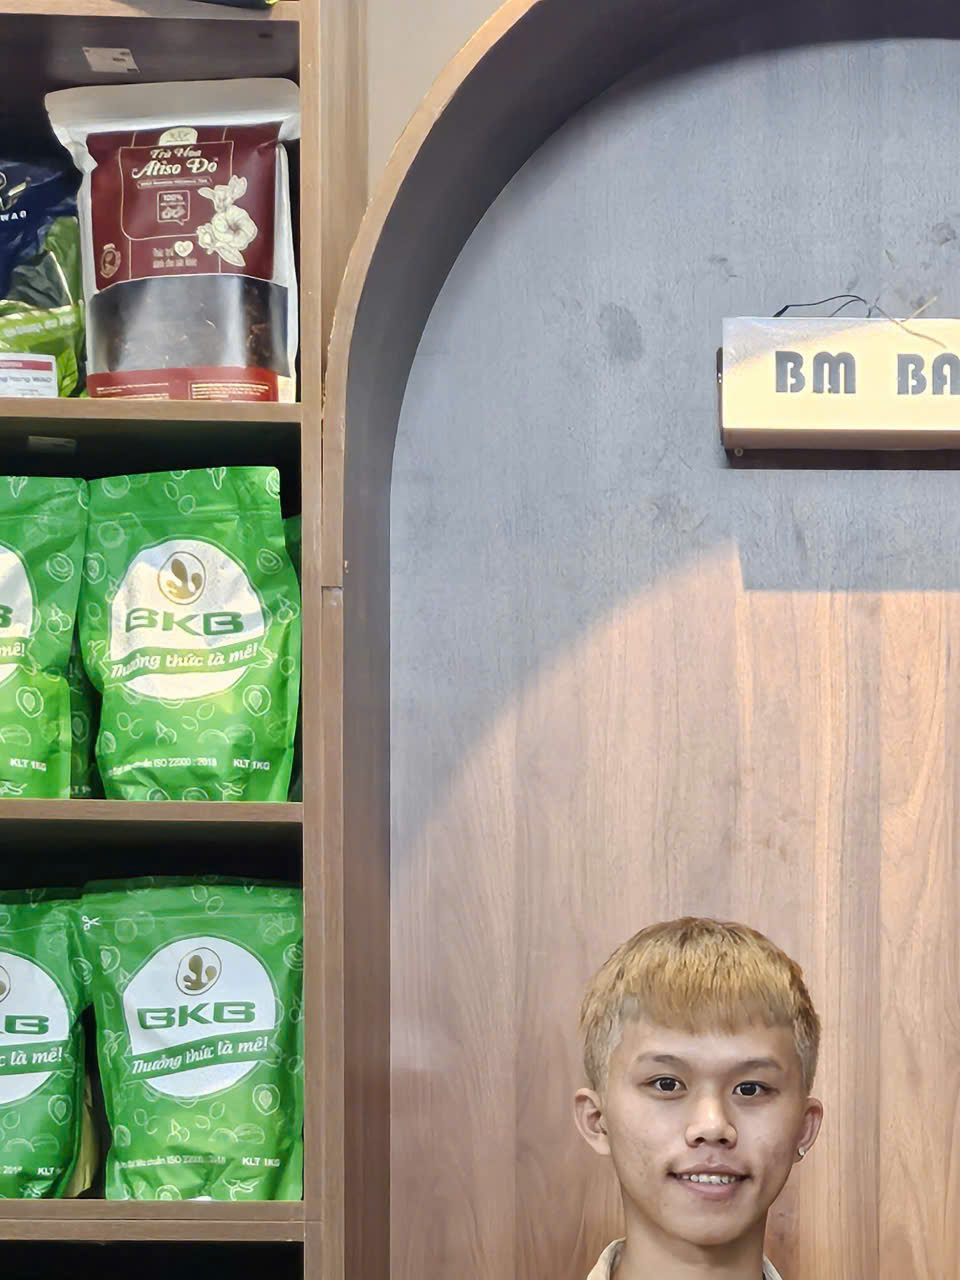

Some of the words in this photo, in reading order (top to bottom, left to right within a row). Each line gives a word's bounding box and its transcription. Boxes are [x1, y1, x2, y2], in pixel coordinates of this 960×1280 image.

[775, 350, 856, 394] BM
[125, 607, 245, 637] BKB
[208, 652, 226, 666] là
[233, 758, 250, 768] KLT
[252, 759, 270, 771] 1KG
[137, 1001, 256, 1030] BKB
[218, 1039, 233, 1056] là
[238, 1035, 269, 1053] mê!
[10, 1050, 27, 1066] là
[32, 1046, 63, 1064] mê!
[37, 1166, 55, 1176] KLT
[242, 1156, 261, 1166] KLT
